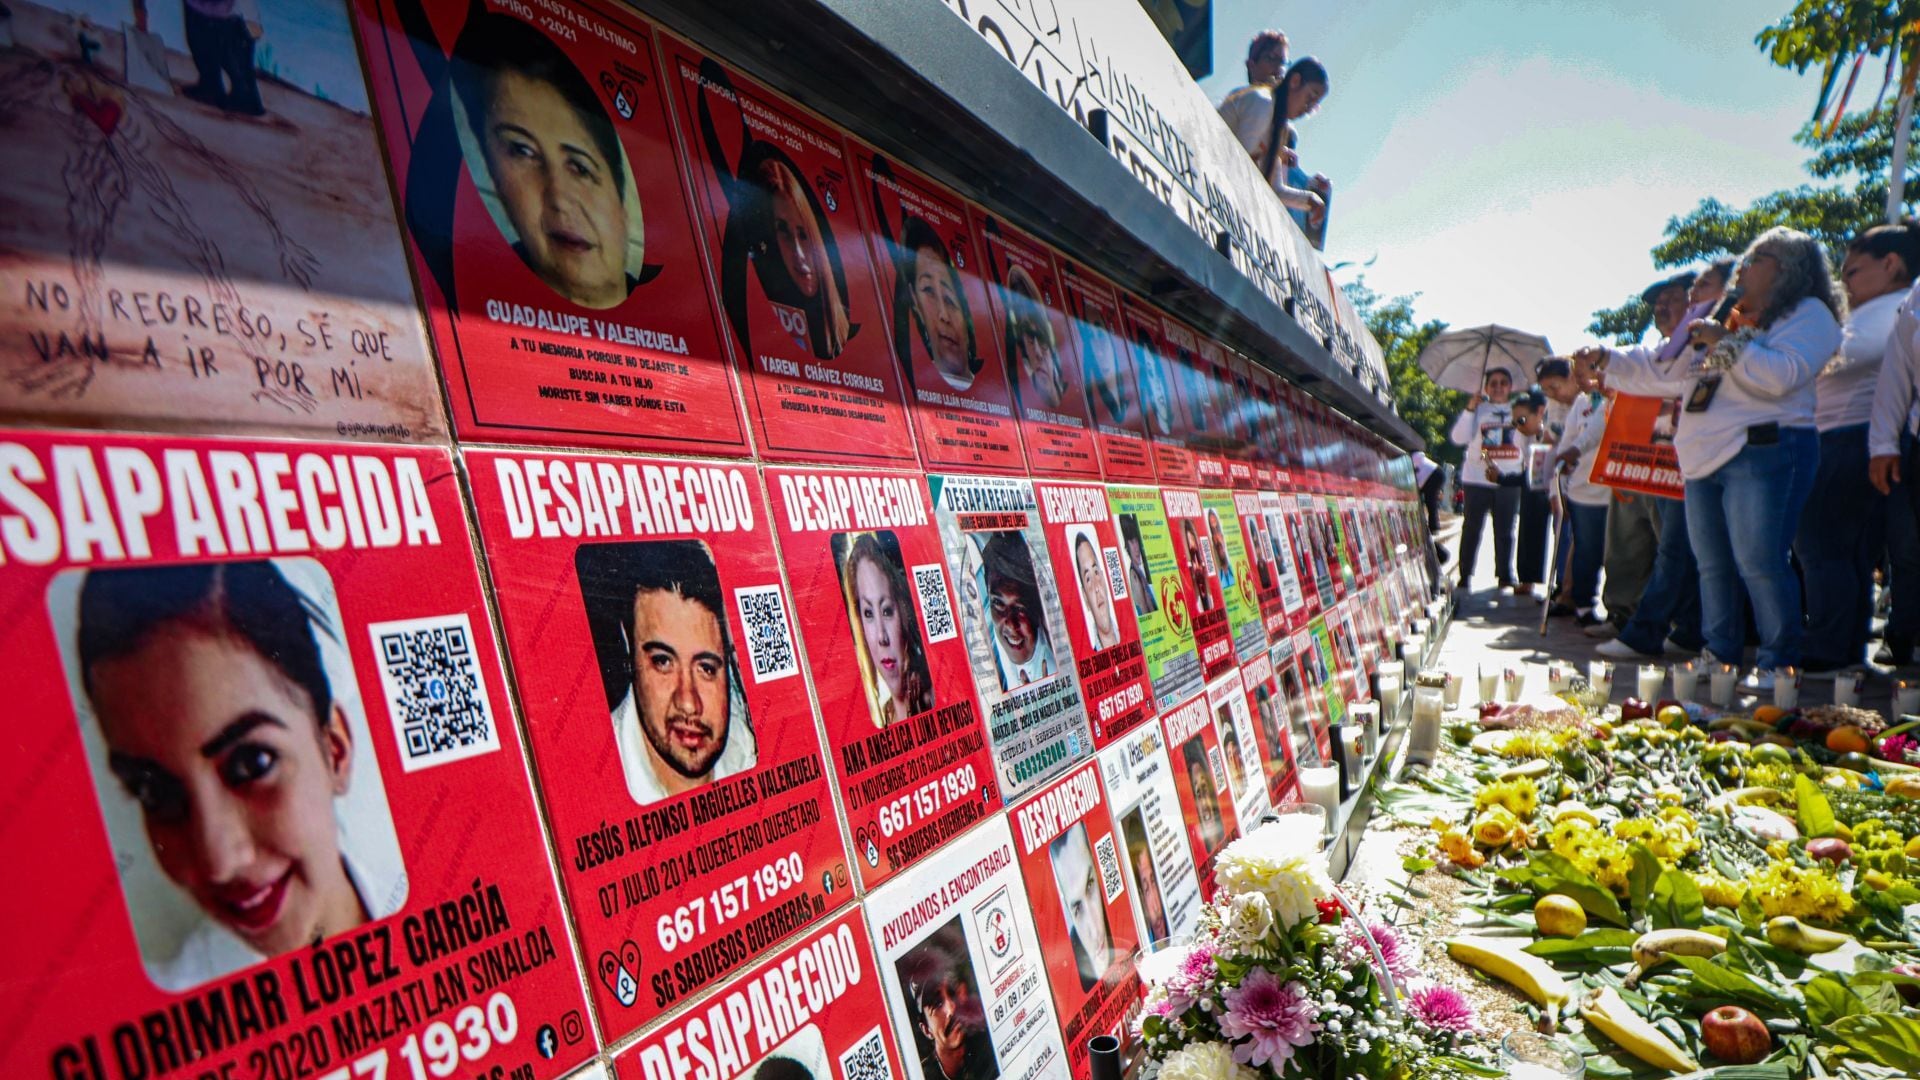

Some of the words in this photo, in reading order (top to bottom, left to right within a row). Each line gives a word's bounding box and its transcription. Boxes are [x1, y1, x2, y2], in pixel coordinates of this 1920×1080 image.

[578, 14, 594, 32] EL
[678, 64, 739, 104] BUSCADORA
[24, 279, 70, 311] NO
[107, 287, 287, 352] REGRESO,
[298, 312, 334, 350] SÉ
[352, 329, 393, 362] QUE
[486, 299, 592, 338] GUADALUPE
[594, 319, 690, 355] VALENZUELA
[510, 337, 519, 350] A
[521, 338, 536, 352] TU
[539, 341, 585, 360] MEMORIA
[587, 349, 623, 366] PORQUE
[625, 355, 638, 368] NO
[640, 358, 676, 374] DEJASTE
[678, 365, 690, 376] DE
[29, 331, 110, 364] VAN
[143, 335, 163, 371] A
[254, 356, 313, 396] POR
[538, 385, 582, 402] MORISTE
[584, 391, 600, 404] SIN
[602, 393, 632, 407] SABER
[569, 367, 607, 384] BUSCAR
[610, 373, 618, 385] A
[619, 375, 632, 387] TU
[760, 355, 800, 377] YAREMI
[804, 362, 841, 384] CHÁVEZ
[843, 372, 884, 393] CORRALES
[0, 441, 441, 567] SAPARECIDA
[495, 458, 754, 539] DESAPARECIDO
[779, 474, 929, 532] DESAPARECIDA
[944, 486, 1024, 512] DESAPARECIDO
[1040, 486, 1108, 524] DESAPARECIDO
[1605, 460, 1621, 477] 01
[1623, 463, 1651, 481] 800
[842, 740, 868, 777] ANA
[865, 721, 915, 766] ANGÉLICA
[912, 713, 938, 750] LUNA
[937, 699, 975, 737] REYNOSO
[848, 783, 862, 810] 01
[861, 766, 909, 804] NOVIEMBRE
[906, 755, 928, 782] 2016
[927, 738, 958, 775] CULIACÁN
[956, 729, 984, 760] SINALOA
[575, 820, 625, 872] JESÚS
[625, 802, 689, 852] ALFONSO
[690, 782, 758, 826] ARGÜELLES
[756, 753, 822, 798] VALENZUELA
[879, 794, 912, 838] 667
[912, 780, 942, 819] 157
[941, 763, 976, 804] 1930
[899, 825, 941, 864] SABUESOS
[937, 799, 978, 839] GUERRERAS
[1017, 766, 1101, 856] DESAPARECIDO
[598, 883, 620, 918] 07
[622, 866, 661, 909] JULIO
[661, 852, 697, 893] 2014
[696, 827, 763, 875] QUERÉTARO
[762, 797, 821, 844] QUERÉTARO
[656, 896, 706, 952] 667
[709, 876, 750, 925] 157
[752, 852, 804, 903] 1930
[882, 892, 941, 952] AYUDANOS
[940, 886, 950, 912] A
[948, 844, 1012, 904] ENCONTRARLO
[51, 968, 289, 1080] GLORIMAR
[291, 935, 401, 1014] LÓPEZ
[402, 877, 511, 967] GARCÍA
[652, 968, 675, 1008] SG
[674, 933, 747, 994] SABUESOS
[745, 892, 812, 954] GUERRERAS
[811, 894, 826, 915] MR
[331, 963, 468, 1058] MAZATLAN
[467, 925, 557, 994] SINALOA
[639, 923, 863, 1080] DESAPARECIDO
[994, 1004, 1004, 1022] 09
[1008, 991, 1018, 1008] 09
[1021, 971, 1038, 996] 2016
[400, 992, 518, 1080] 1930
[1033, 1045, 1053, 1072] LEYVA
